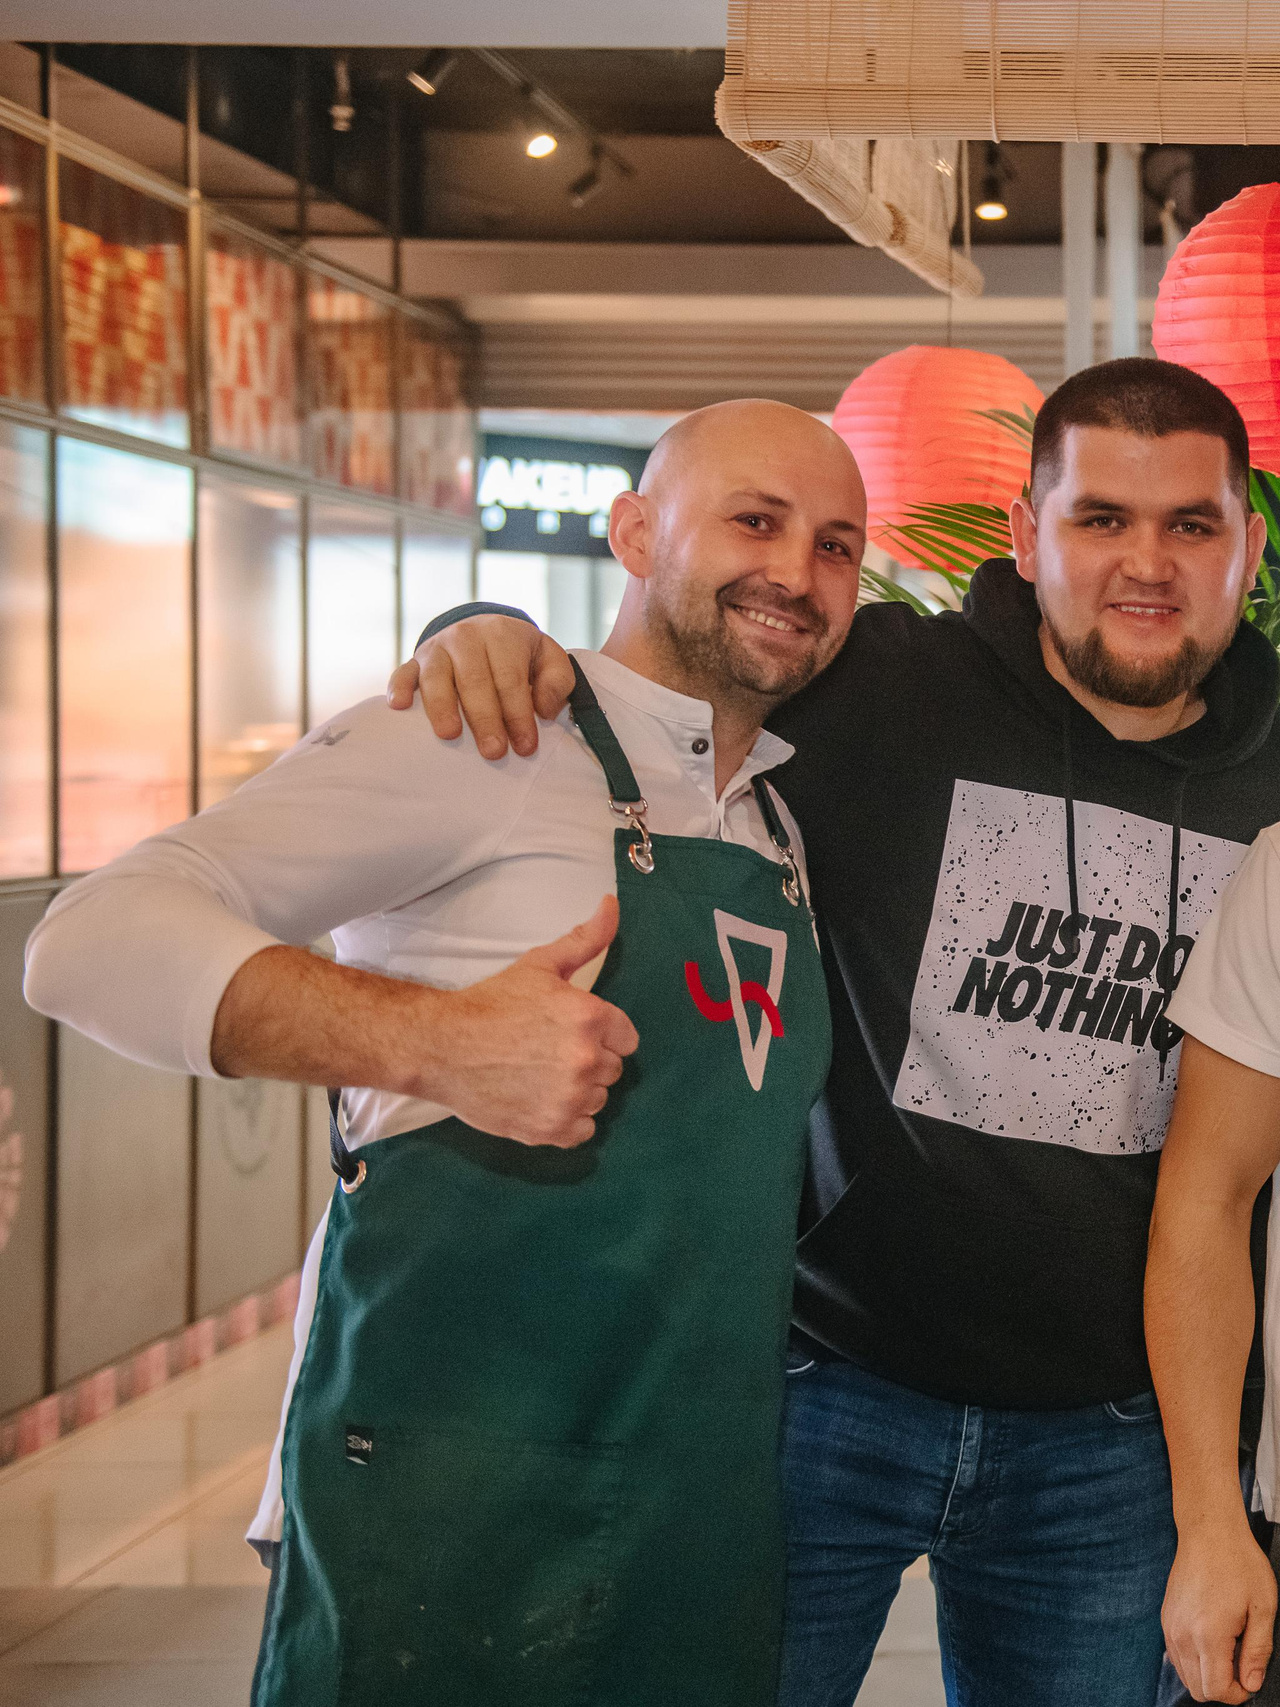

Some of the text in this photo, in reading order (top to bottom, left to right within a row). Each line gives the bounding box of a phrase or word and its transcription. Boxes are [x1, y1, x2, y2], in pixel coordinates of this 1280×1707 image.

[476, 455, 632, 515] AKEUP
[984, 900, 1196, 991] JUST DO
